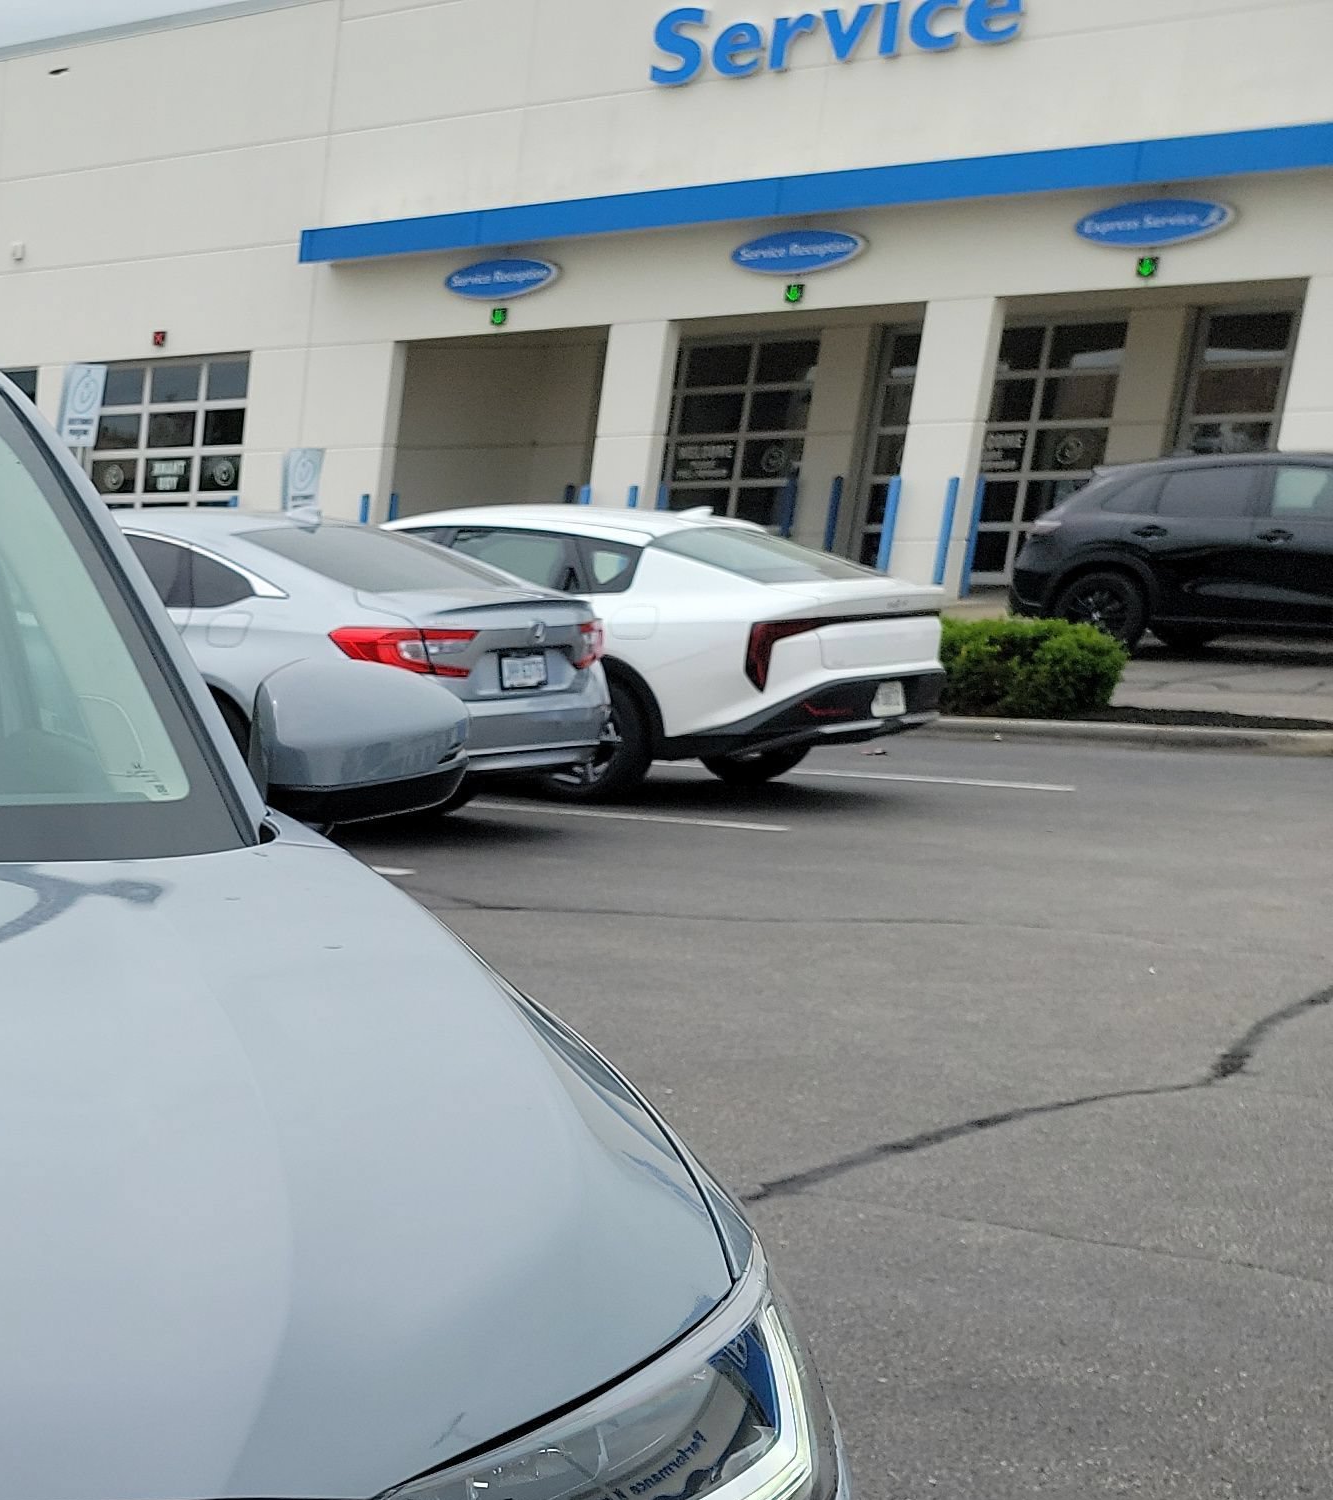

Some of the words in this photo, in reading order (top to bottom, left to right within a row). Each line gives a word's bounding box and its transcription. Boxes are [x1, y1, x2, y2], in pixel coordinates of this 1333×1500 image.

[648, 0, 1024, 87] Service
[1084, 219, 1140, 235] Express
[1143, 213, 1200, 229] Service
[738, 247, 786, 261] Service
[789, 242, 856, 257] Reception
[451, 274, 492, 287] Service
[493, 269, 550, 284] Reception
